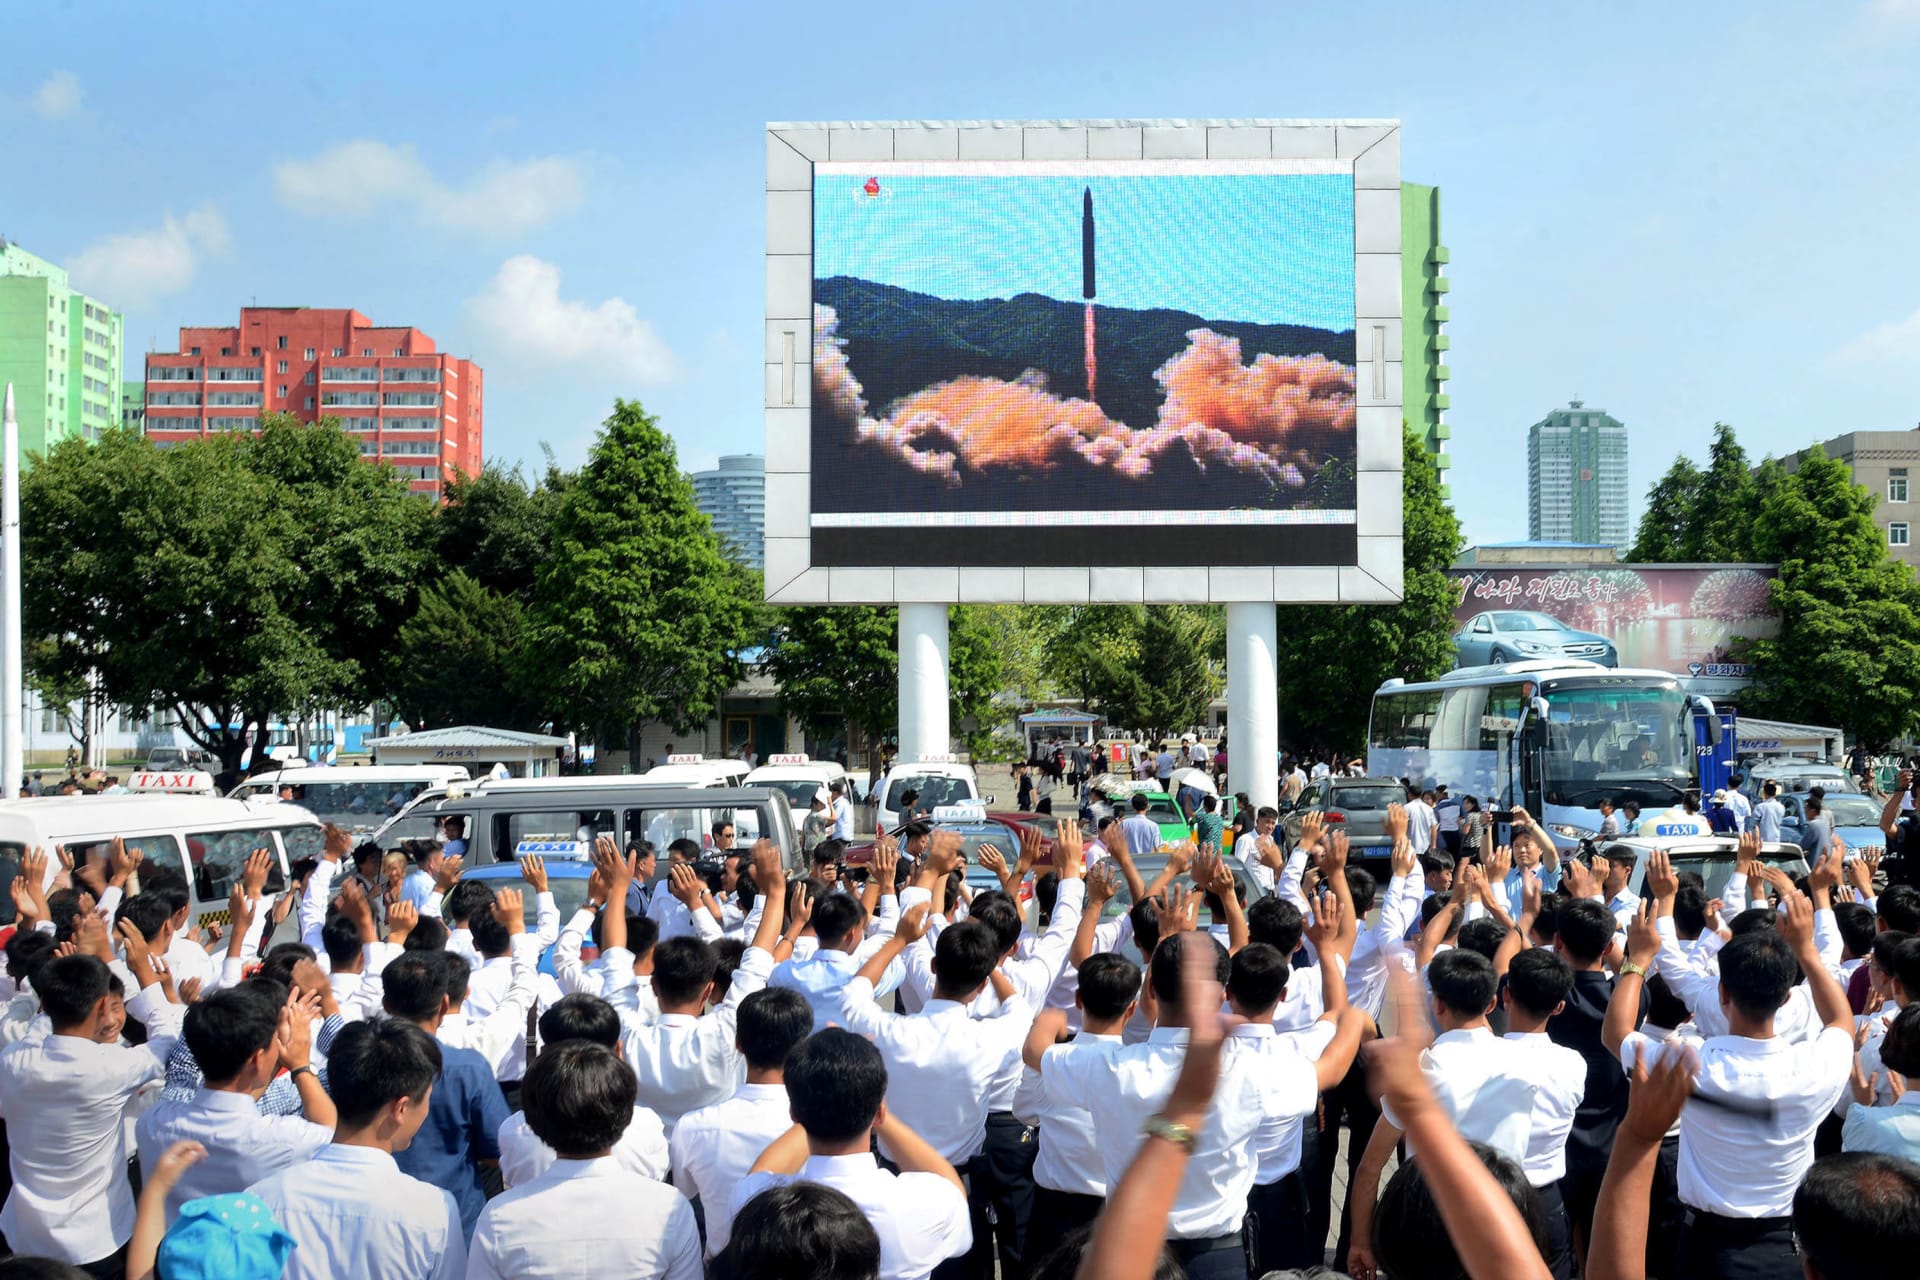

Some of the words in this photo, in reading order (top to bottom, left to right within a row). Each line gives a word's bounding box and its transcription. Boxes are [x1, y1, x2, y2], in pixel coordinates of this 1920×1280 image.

[1473, 575, 1522, 604] 나라
[671, 754, 697, 762] TAXI
[773, 755, 803, 763] TAXI
[138, 774, 195, 787] TAXI
[944, 809, 974, 817] TAXI
[1663, 824, 1693, 836] TAXI
[524, 843, 572, 851] TAXI
